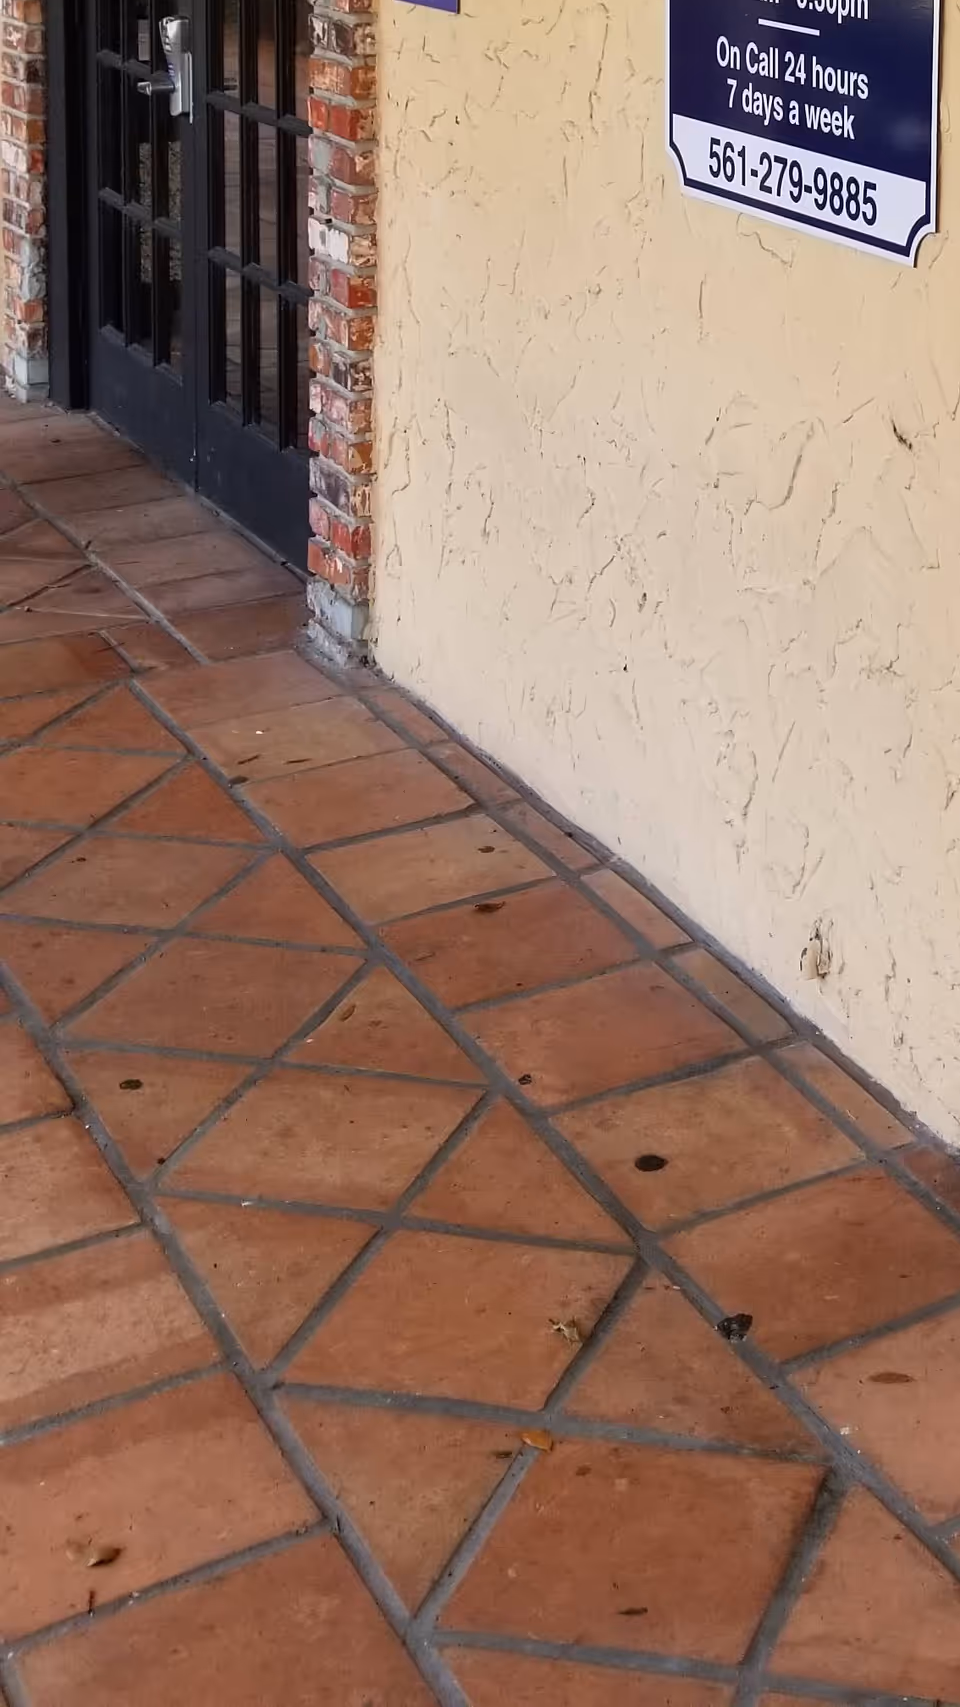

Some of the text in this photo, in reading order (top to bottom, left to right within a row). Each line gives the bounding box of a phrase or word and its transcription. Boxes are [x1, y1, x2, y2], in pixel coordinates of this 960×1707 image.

[716, 35, 869, 100] On Call 24 hours
[726, 78, 855, 140] 7 days a week
[708, 136, 878, 227] 561-279-9885
